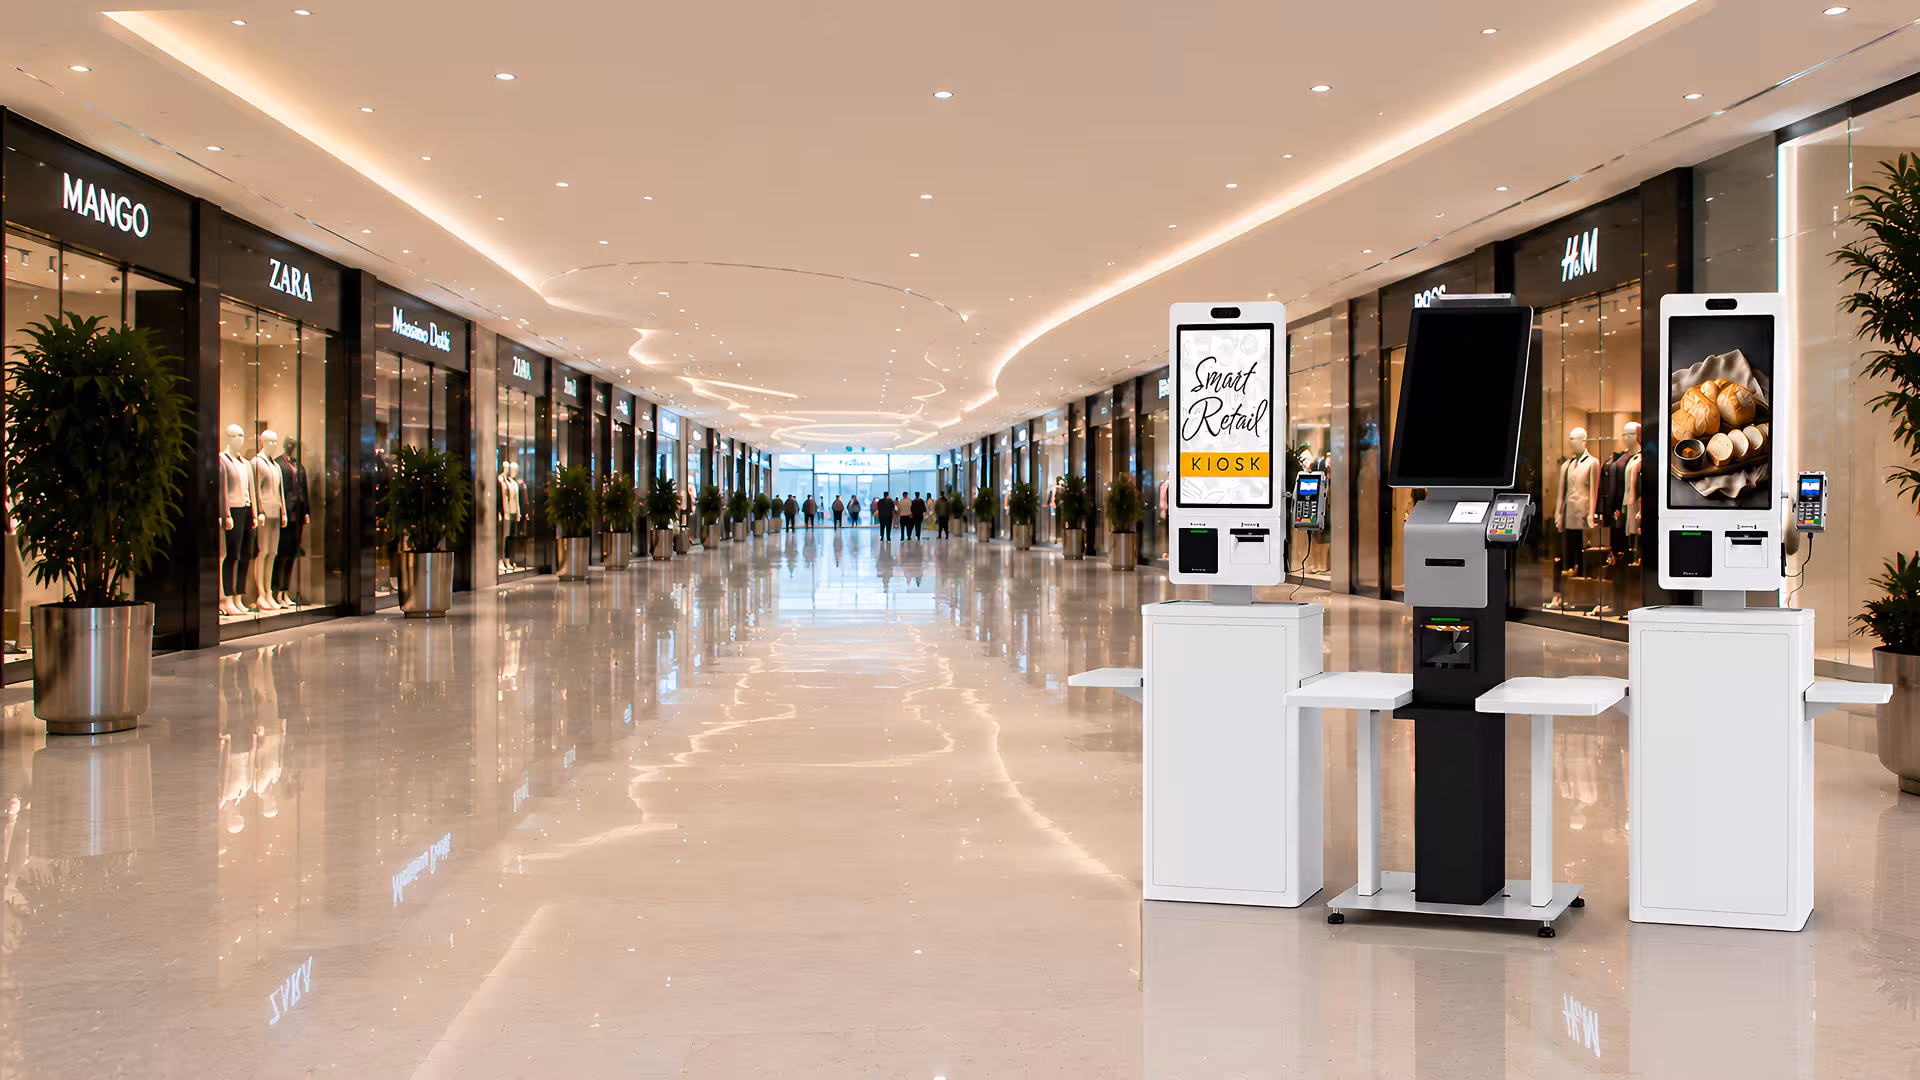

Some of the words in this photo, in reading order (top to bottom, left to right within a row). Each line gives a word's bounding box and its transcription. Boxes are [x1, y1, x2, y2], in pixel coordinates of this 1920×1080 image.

[62, 172, 150, 239] MANGO
[1561, 227, 1599, 283] H&M
[269, 257, 313, 303] ZARA
[1190, 356, 1258, 395] Smart
[1181, 396, 1268, 442] Retail
[1191, 456, 1260, 472] KIOSK
